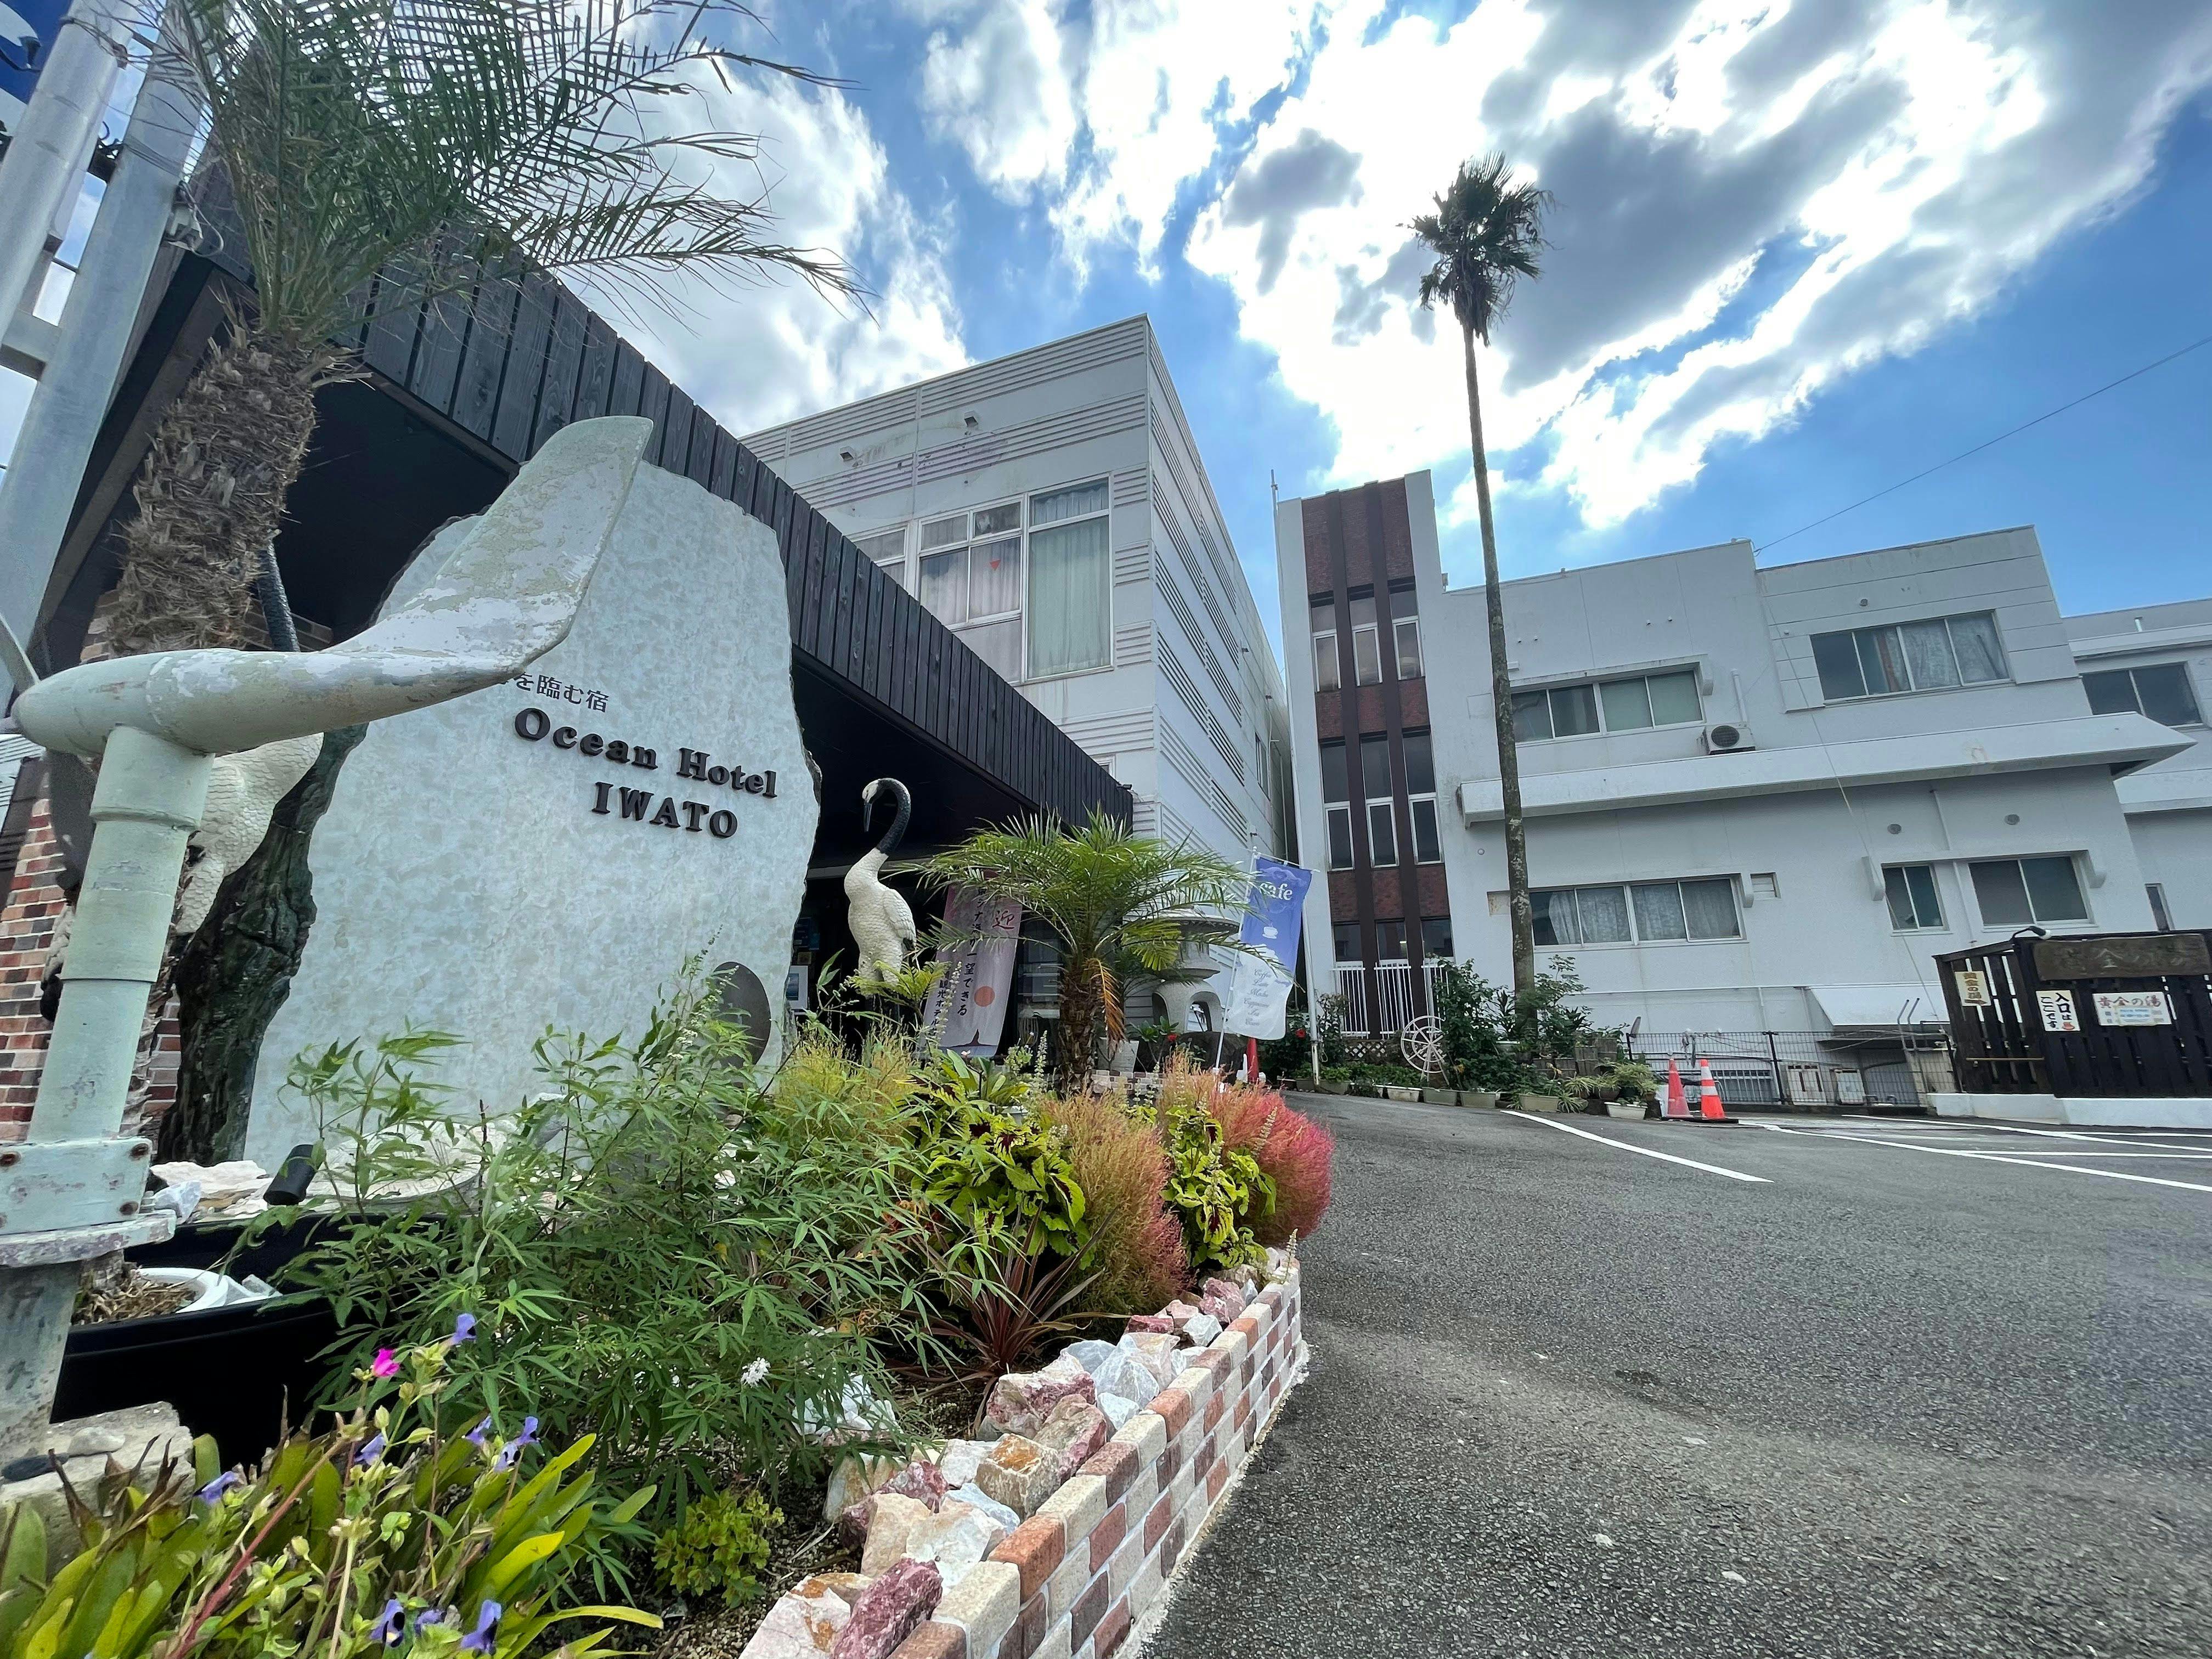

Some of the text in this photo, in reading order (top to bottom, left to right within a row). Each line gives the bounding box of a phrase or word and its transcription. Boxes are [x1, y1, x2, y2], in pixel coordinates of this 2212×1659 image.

[501, 672, 610, 713] を臨む宿
[515, 708, 777, 798] Ocean Hotel
[591, 781, 738, 838] IWATO
